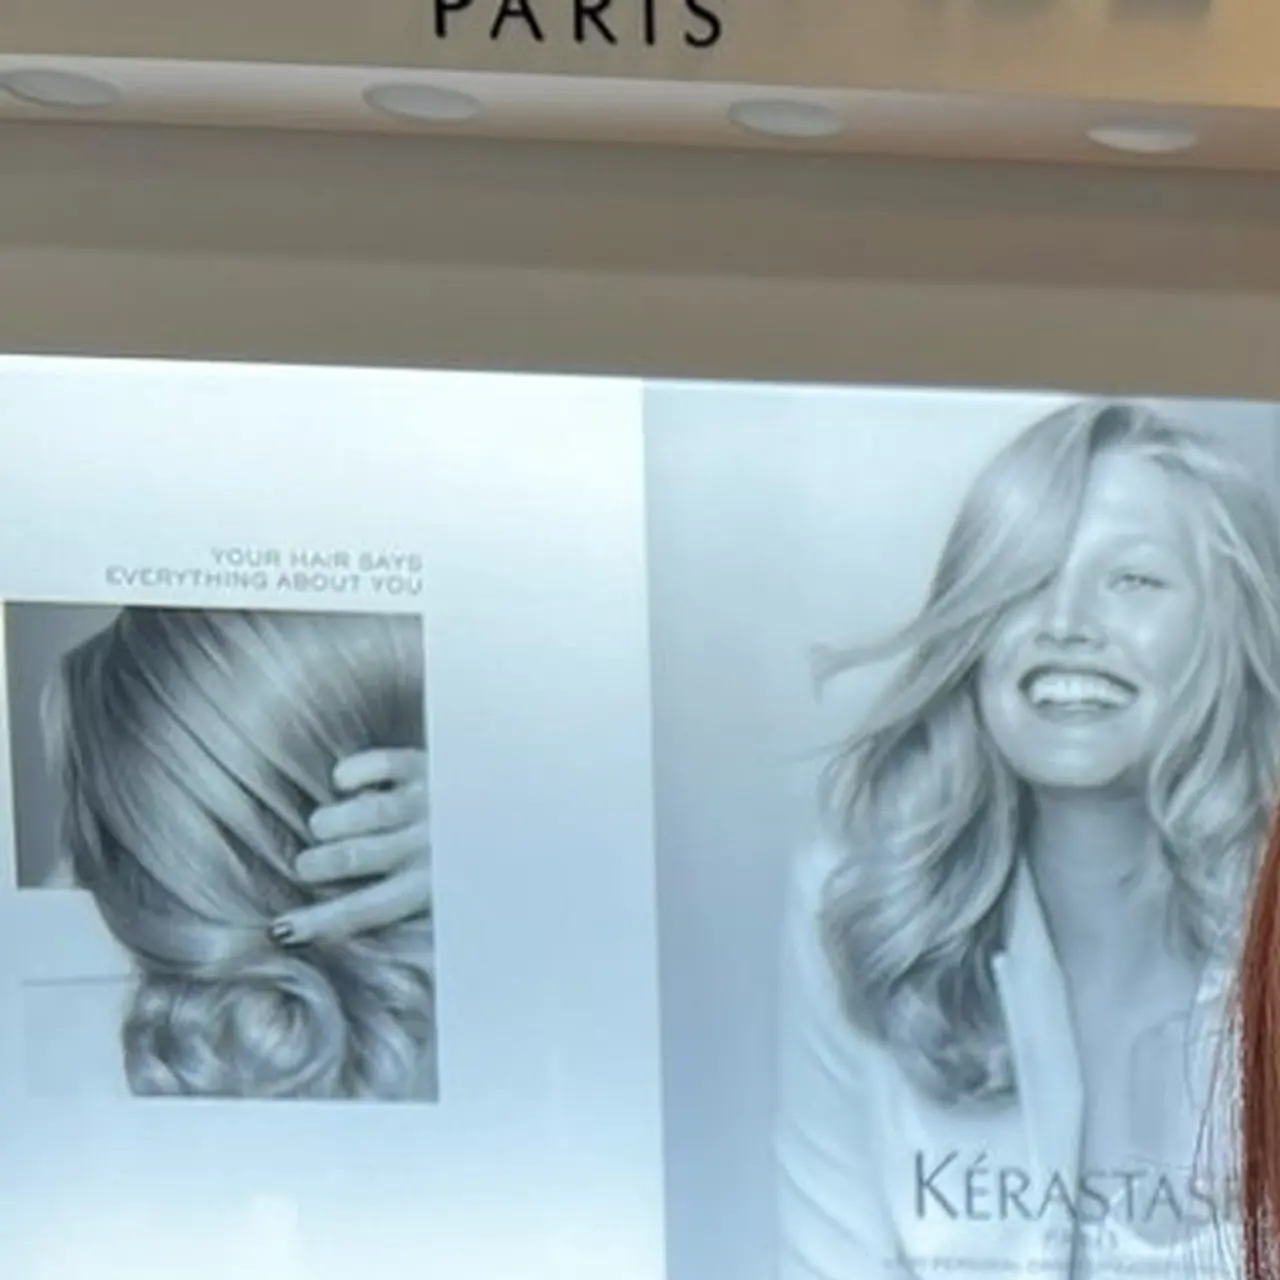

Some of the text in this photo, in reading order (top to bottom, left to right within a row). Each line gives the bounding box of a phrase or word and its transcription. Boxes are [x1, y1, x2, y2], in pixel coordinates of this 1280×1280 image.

[434, 0, 722, 47] PARIS
[211, 547, 423, 573] YOUR HAIR SAYS
[105, 565, 423, 596] EVERYTHING ABOUT YOU
